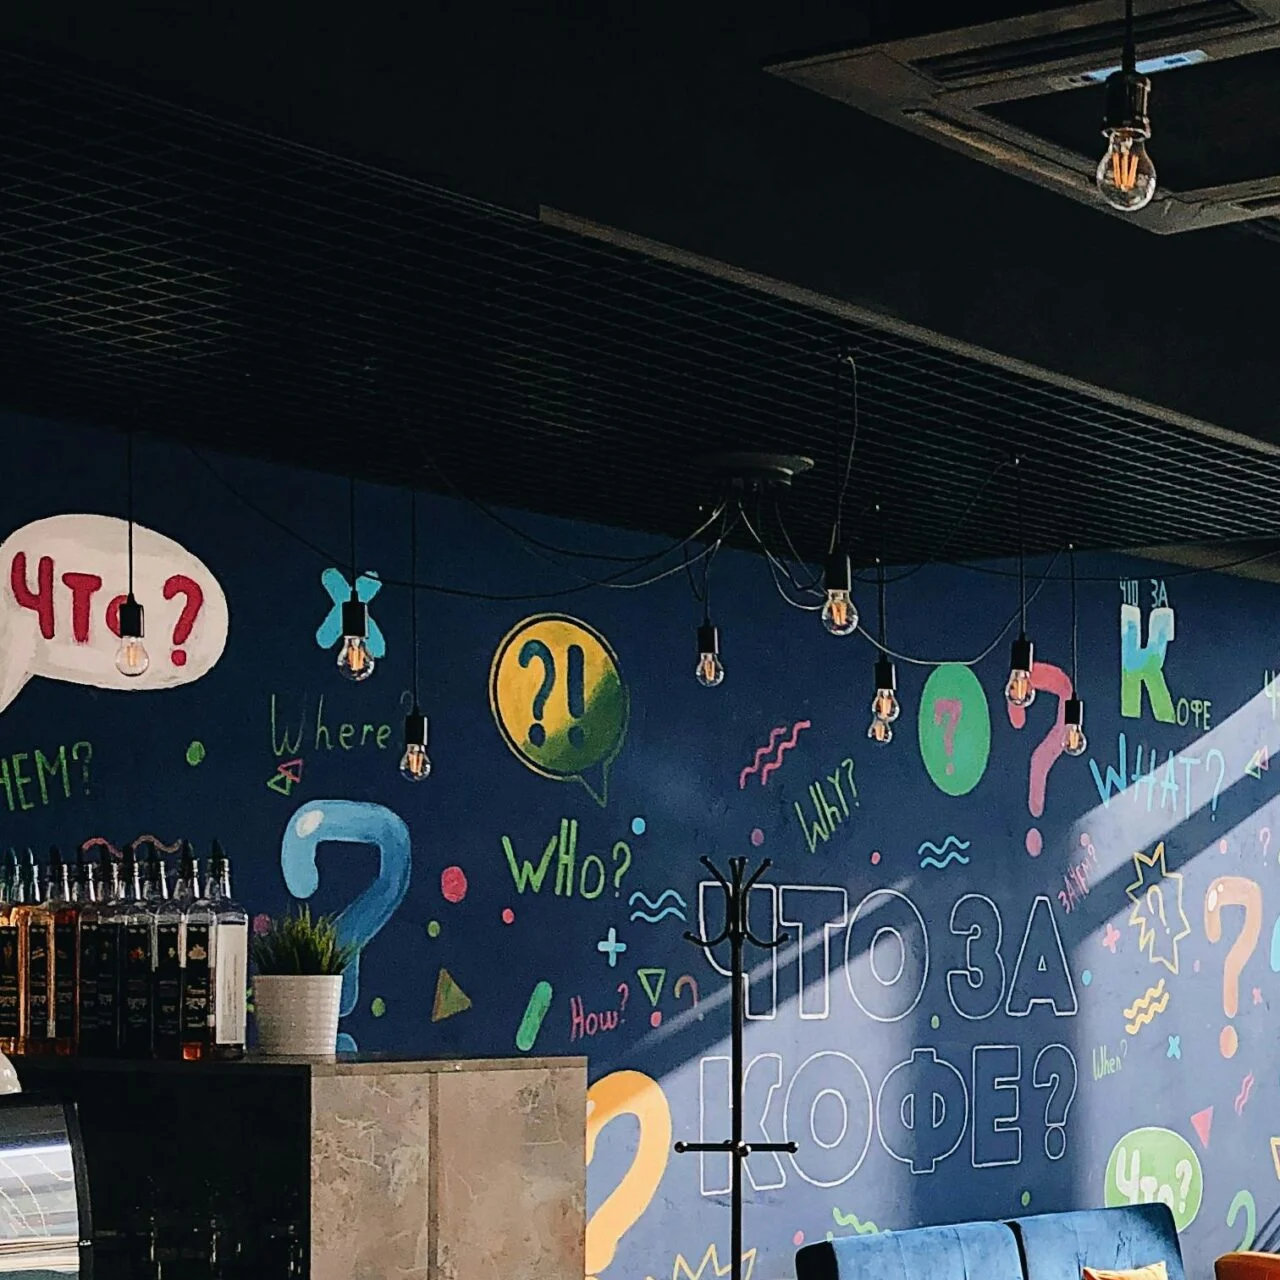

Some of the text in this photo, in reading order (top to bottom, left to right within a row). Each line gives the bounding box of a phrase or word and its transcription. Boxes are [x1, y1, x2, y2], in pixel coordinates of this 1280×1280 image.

[1089, 732, 1226, 823] WHAT?
[699, 880, 1078, 1022] ЧТО ЗА
[570, 983, 629, 1042] How?
[699, 1043, 1078, 1196] КОФЕ?
